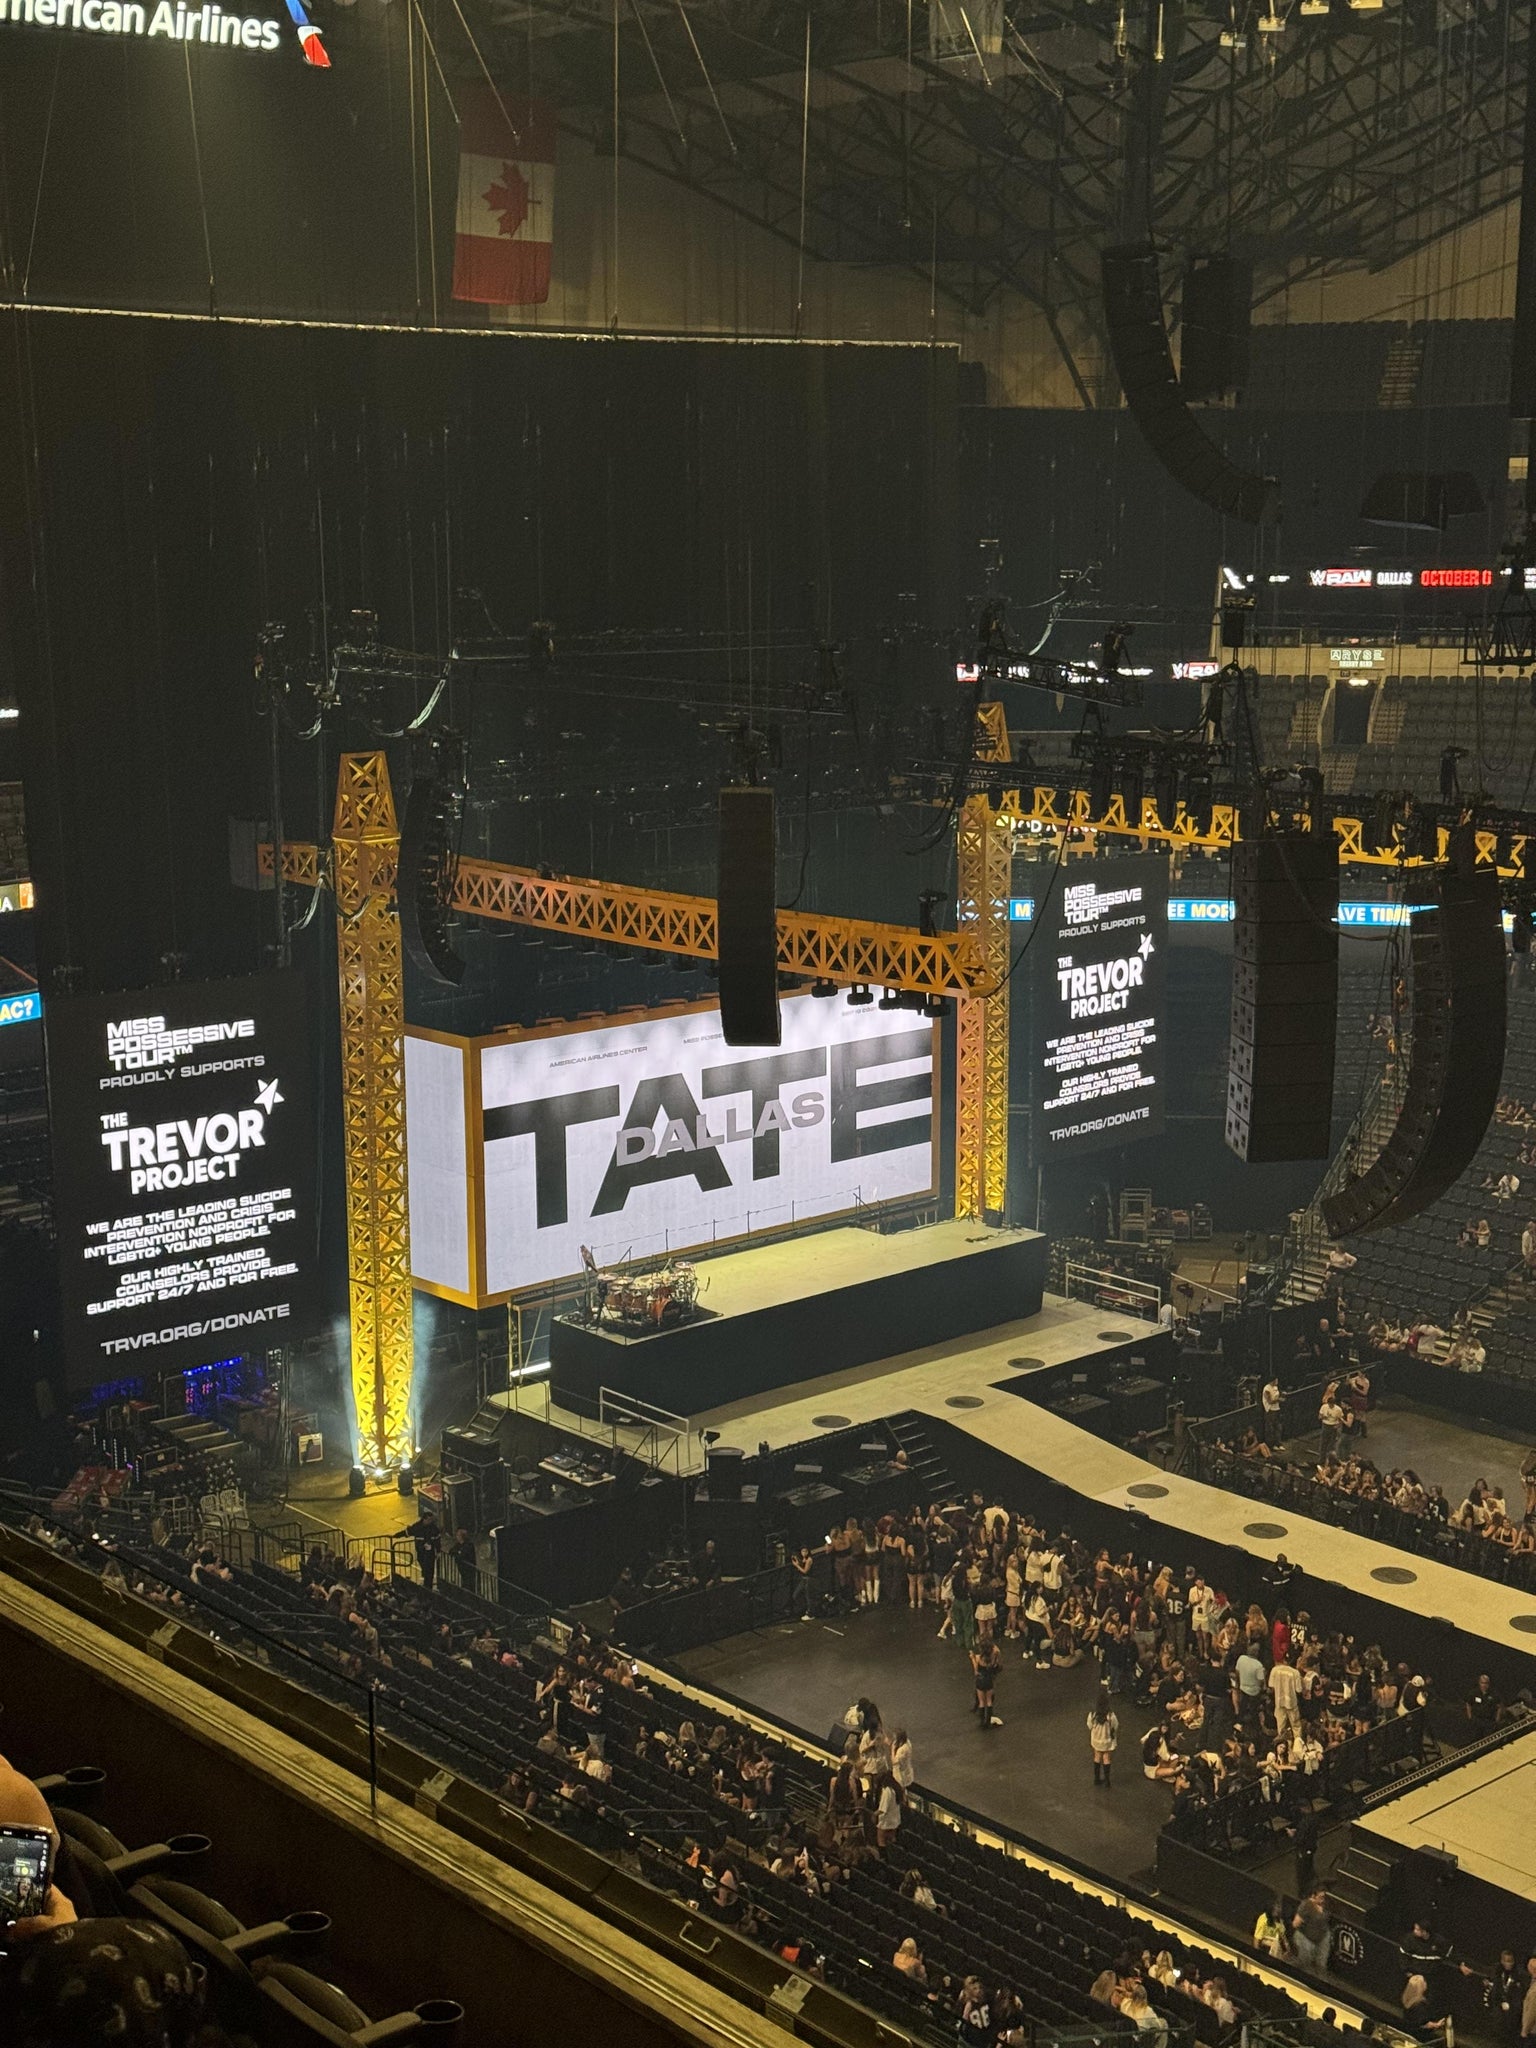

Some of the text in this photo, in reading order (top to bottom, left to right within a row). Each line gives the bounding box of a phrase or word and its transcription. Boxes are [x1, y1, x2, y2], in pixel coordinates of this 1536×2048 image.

[0, 0, 280, 50] merican Airlines
[1326, 569, 1372, 586] RAW
[1377, 572, 1413, 585] DALLAS
[1420, 570, 1480, 586] OCTOBER
[1064, 883, 1096, 900] MISS
[1064, 888, 1142, 913] POSSESSIVE
[1059, 916, 1146, 938] PROUDLY SUPPORTS
[1057, 956, 1072, 968] THE
[1057, 956, 1143, 1001] TREVOR
[1071, 990, 1129, 1019] PROJECT
[107, 1016, 165, 1039] MISS
[108, 1019, 255, 1055] POSSESSIVE
[701, 1033, 722, 1041] POSSE
[1046, 1041, 1059, 1049] WE
[1060, 1035, 1076, 1046] ARE
[1078, 1032, 1093, 1042] THE
[1094, 1025, 1125, 1038] LEADING
[550, 1046, 648, 1068] AMERICAN AIRLINES CENTER
[1044, 1034, 1156, 1066] INTERVENTION NONPROFIT FOR
[1056, 1039, 1104, 1055] PREVENTION
[1105, 1035, 1120, 1044] AND
[1086, 1053, 1111, 1066] YOUNG
[100, 1055, 265, 1089] PROUDLY SUPPORTS
[1059, 1071, 1141, 1097] COUNSELORS PROVIDE
[1062, 1064, 1138, 1087] OUR HIGHLY TRAINED
[1044, 1095, 1079, 1110] SUPPORT
[1080, 1090, 1100, 1101] 24/7
[1101, 1085, 1117, 1096] AND
[1118, 1081, 1133, 1091] FOR
[100, 1112, 128, 1129] THE
[483, 1027, 933, 1229] TATE
[616, 1092, 824, 1167] DALLAS
[1050, 1107, 1149, 1141] TRVR.ORG/DONATE
[102, 1109, 266, 1171] TREVOR
[131, 1153, 240, 1194] PROJECT
[86, 1188, 291, 1235] WE ARE THE LEADING SUICIDE
[107, 1203, 273, 1242] PREVENTION AND CRISIS
[84, 1209, 295, 1258] INTERVENTION NONPROFIT FOR
[108, 1226, 270, 1265] LGBTQ+ YOUNG PEOPLE.
[116, 1258, 270, 1297] COUNSELORS PROVIDE
[121, 1248, 265, 1285] OUR HIGHLY TRAINED
[87, 1263, 298, 1315] SUPPORT 24/7 AND FOR FREE.
[101, 1304, 290, 1355] TRVR.ORG/DONATE
[1290, 1628, 1305, 1644] 24
